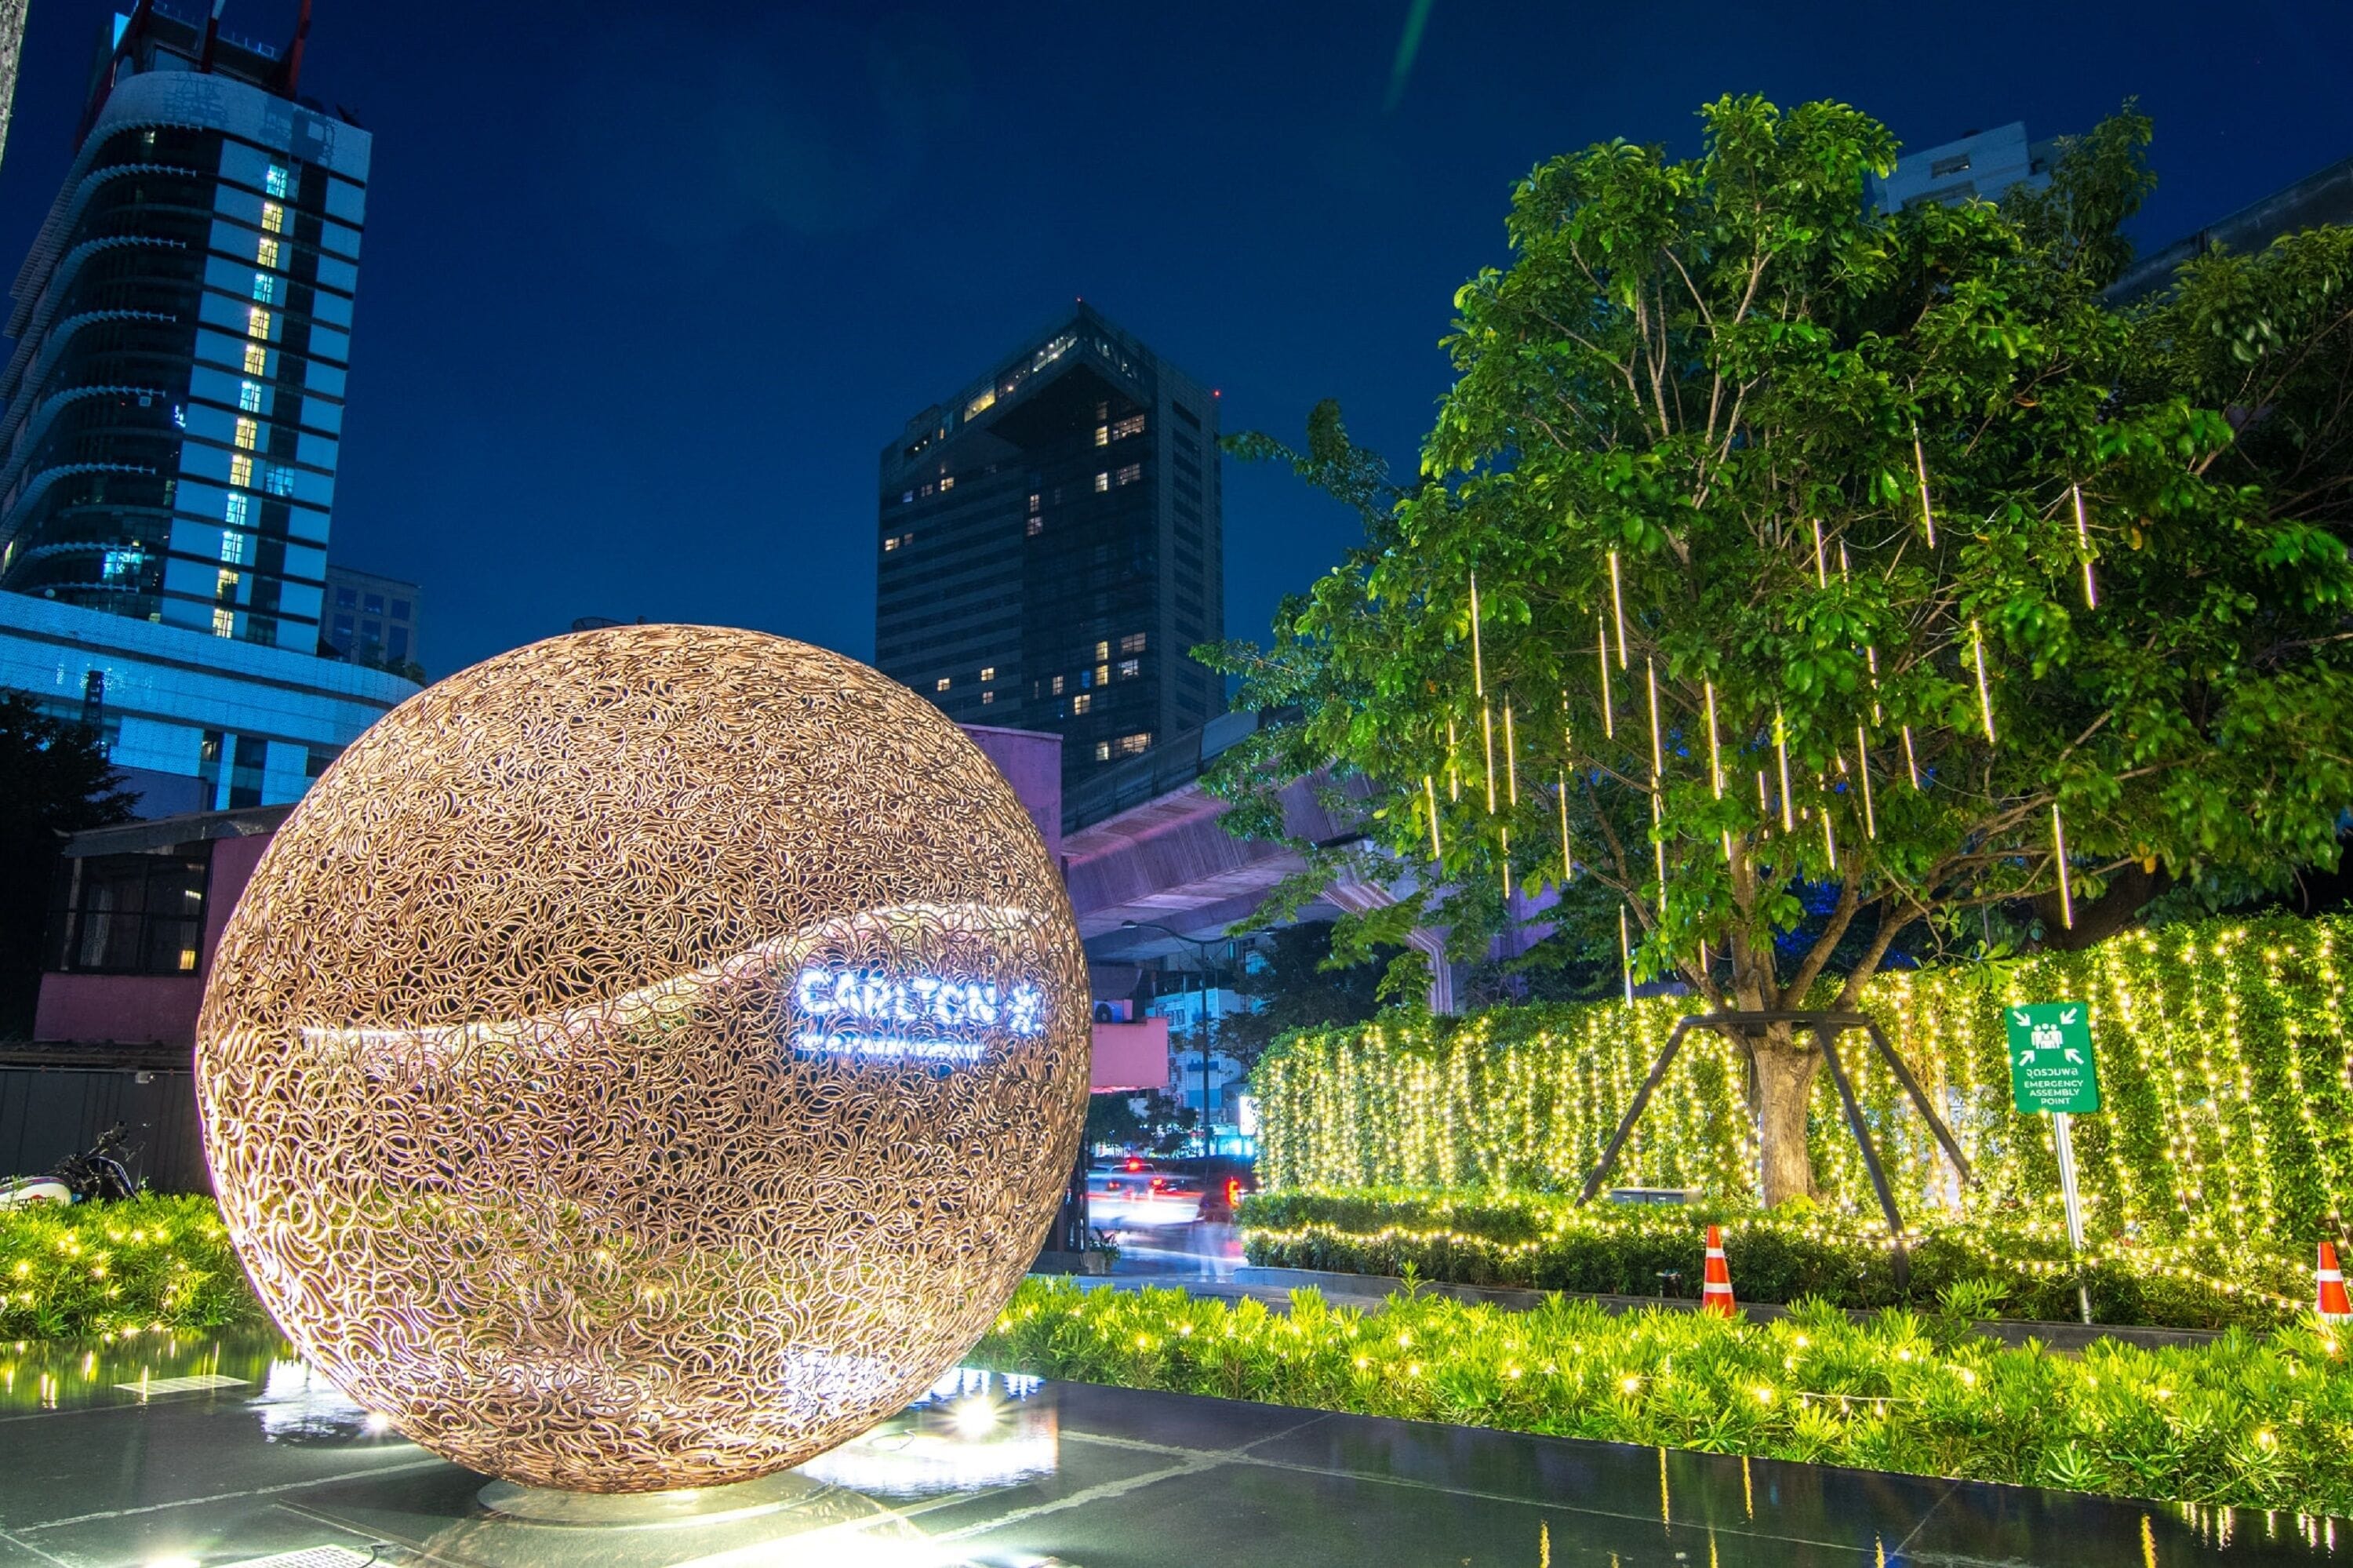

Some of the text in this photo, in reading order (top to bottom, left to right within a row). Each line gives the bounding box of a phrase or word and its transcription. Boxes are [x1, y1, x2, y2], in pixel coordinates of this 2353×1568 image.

[2026, 1068, 2078, 1079] จุดรวมพล
[2030, 1088, 2080, 1097] ASSEMBLY
